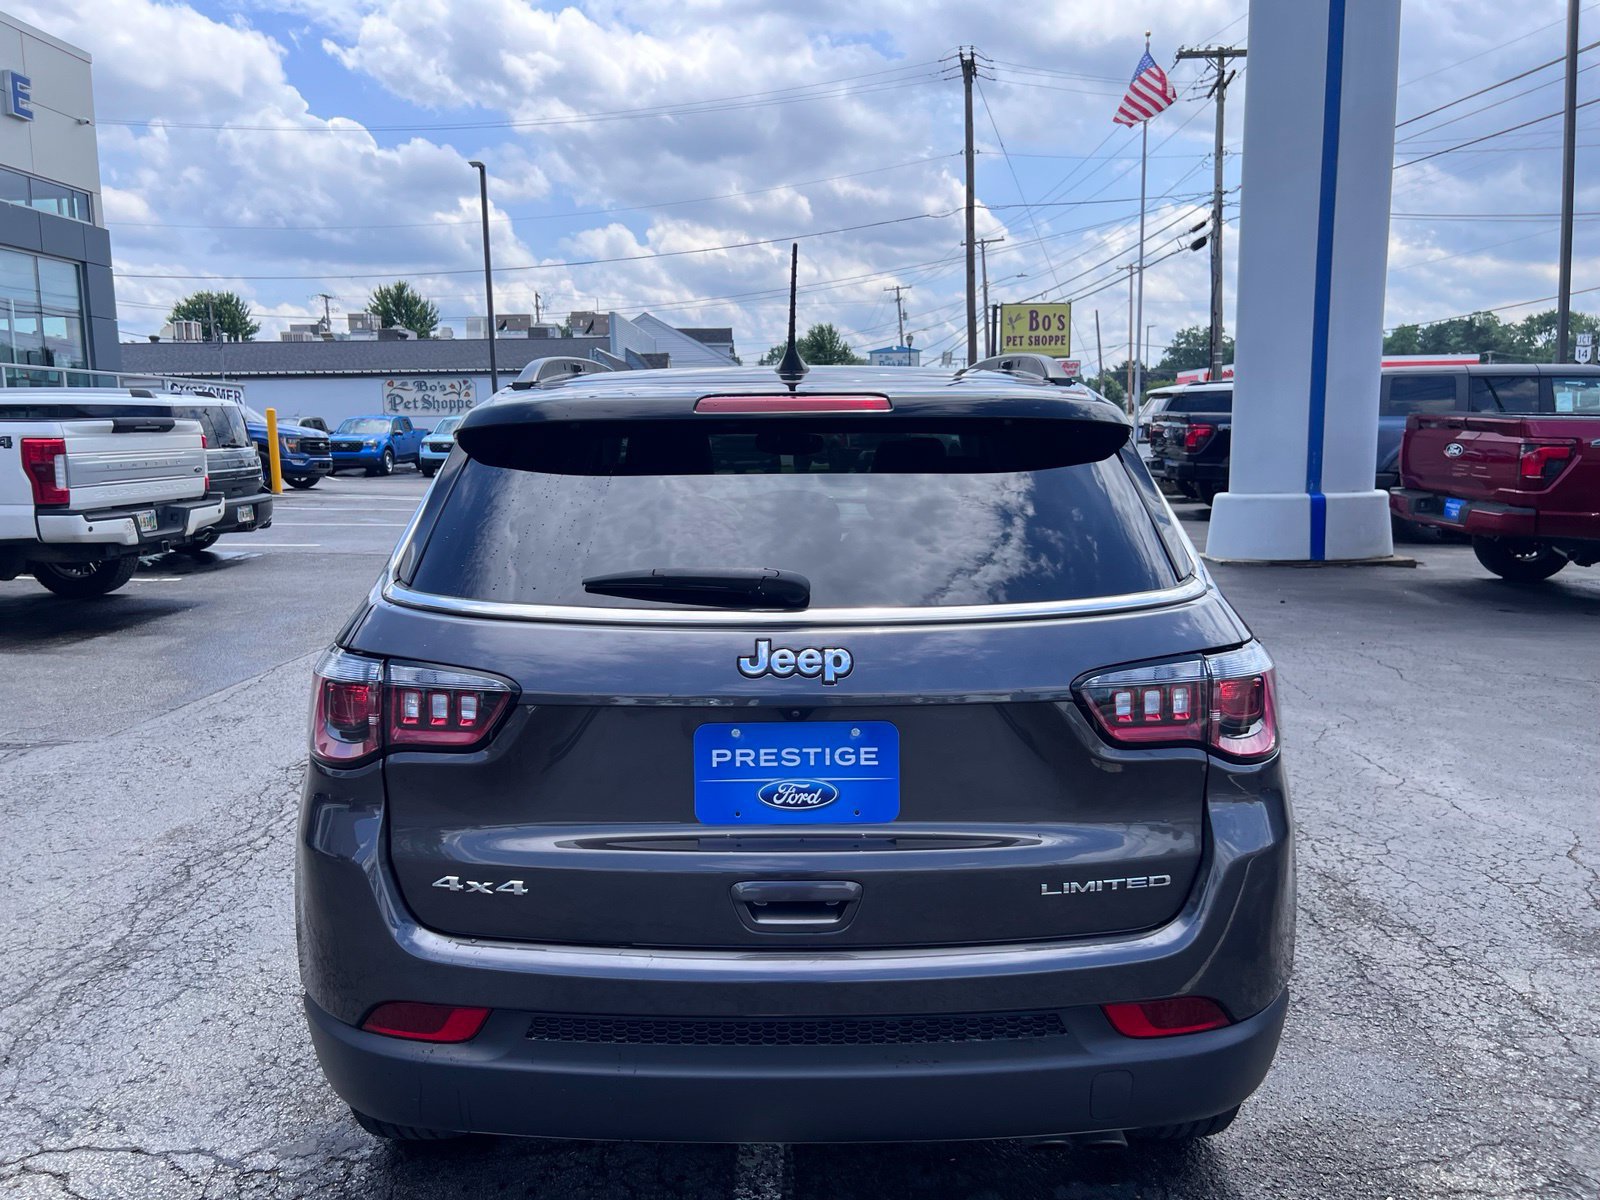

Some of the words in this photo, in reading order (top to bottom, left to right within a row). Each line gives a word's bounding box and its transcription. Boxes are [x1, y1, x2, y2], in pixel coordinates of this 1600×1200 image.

[9, 71, 34, 121] E
[1006, 335, 1025, 347] PET
[1028, 335, 1067, 347] SHOPPE
[1577, 349, 1588, 359] 14
[413, 380, 447, 393] Bo's
[386, 393, 419, 412] Pet
[420, 394, 473, 414] Shoppe
[737, 638, 854, 686] Jeep
[711, 746, 879, 768] PRESTIGE
[772, 781, 823, 805] Ford
[431, 875, 529, 896] 4x4
[1041, 874, 1172, 896] LIMITED
